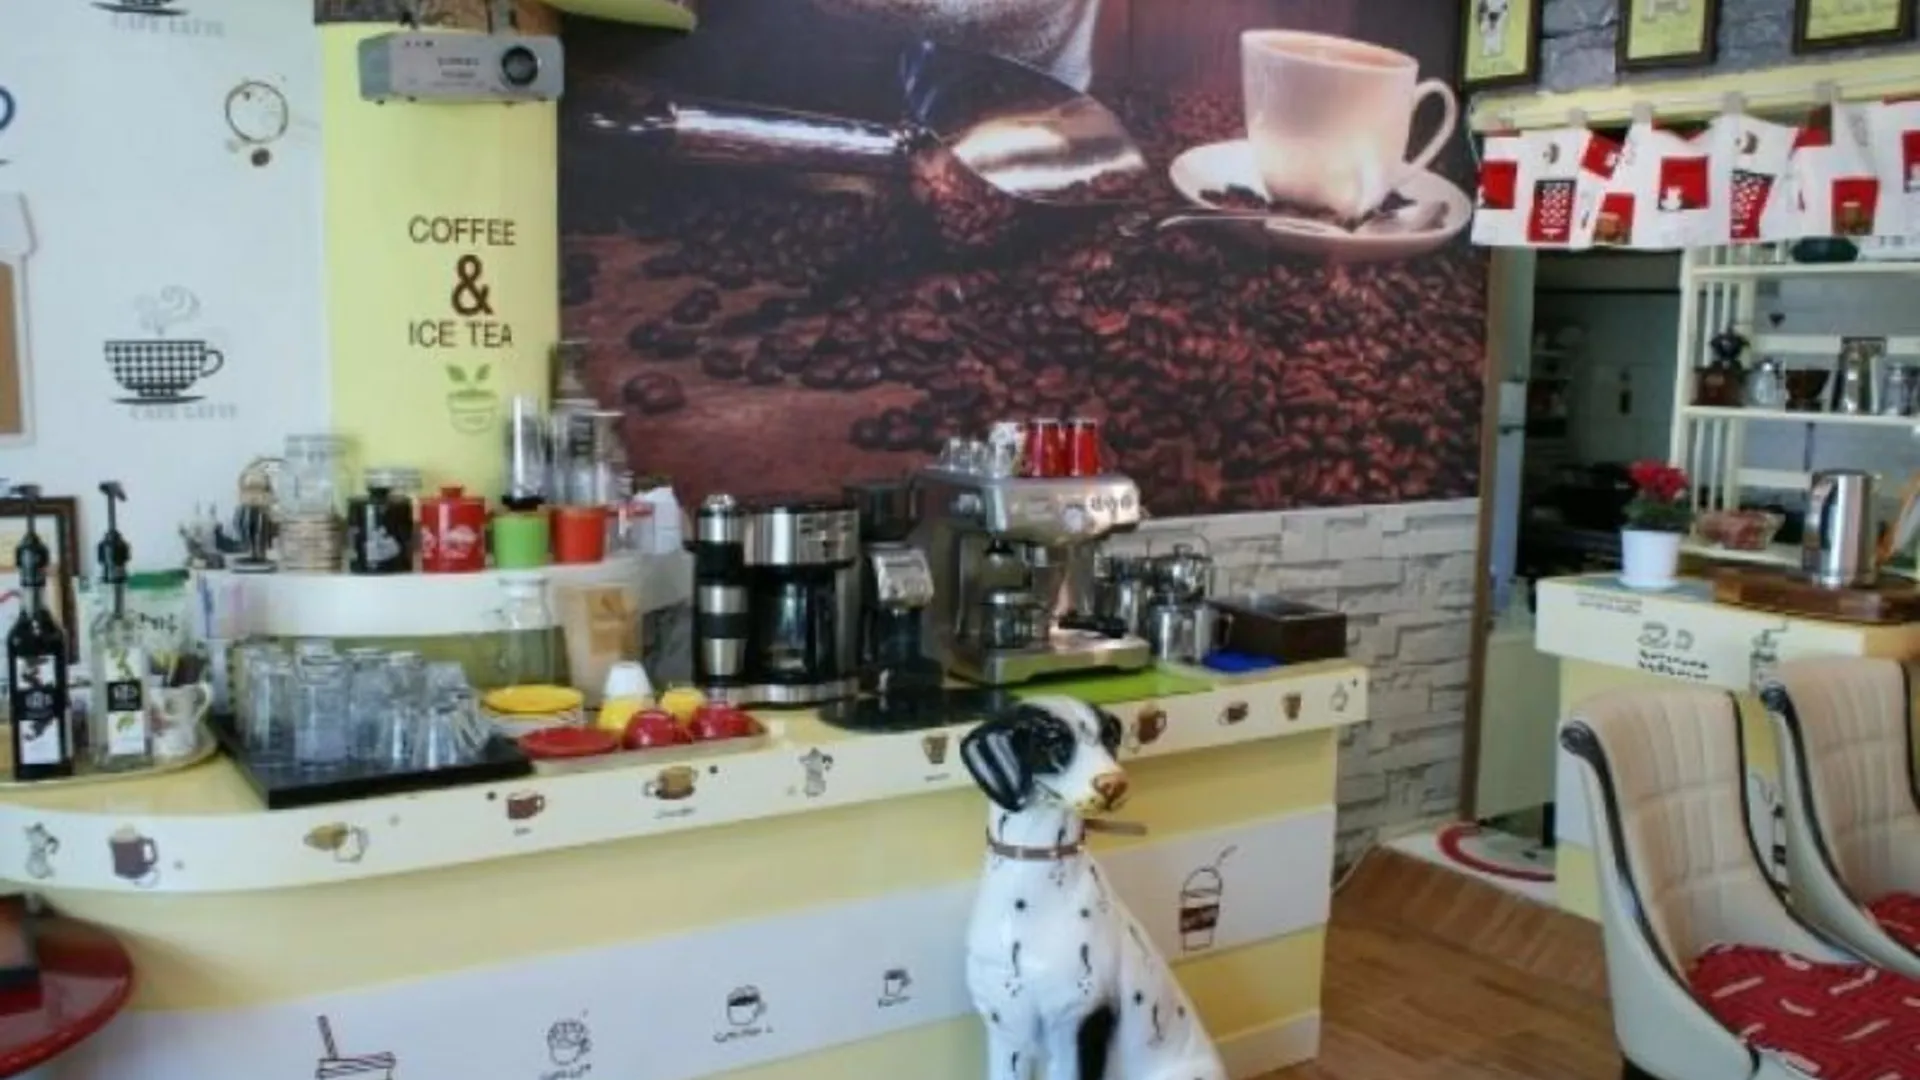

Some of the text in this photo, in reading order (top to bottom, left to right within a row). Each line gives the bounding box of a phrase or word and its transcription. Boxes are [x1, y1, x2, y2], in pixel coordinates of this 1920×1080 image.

[408, 215, 517, 246] COFFEE
[451, 254, 494, 316] &
[408, 319, 513, 348] ICE TEA
